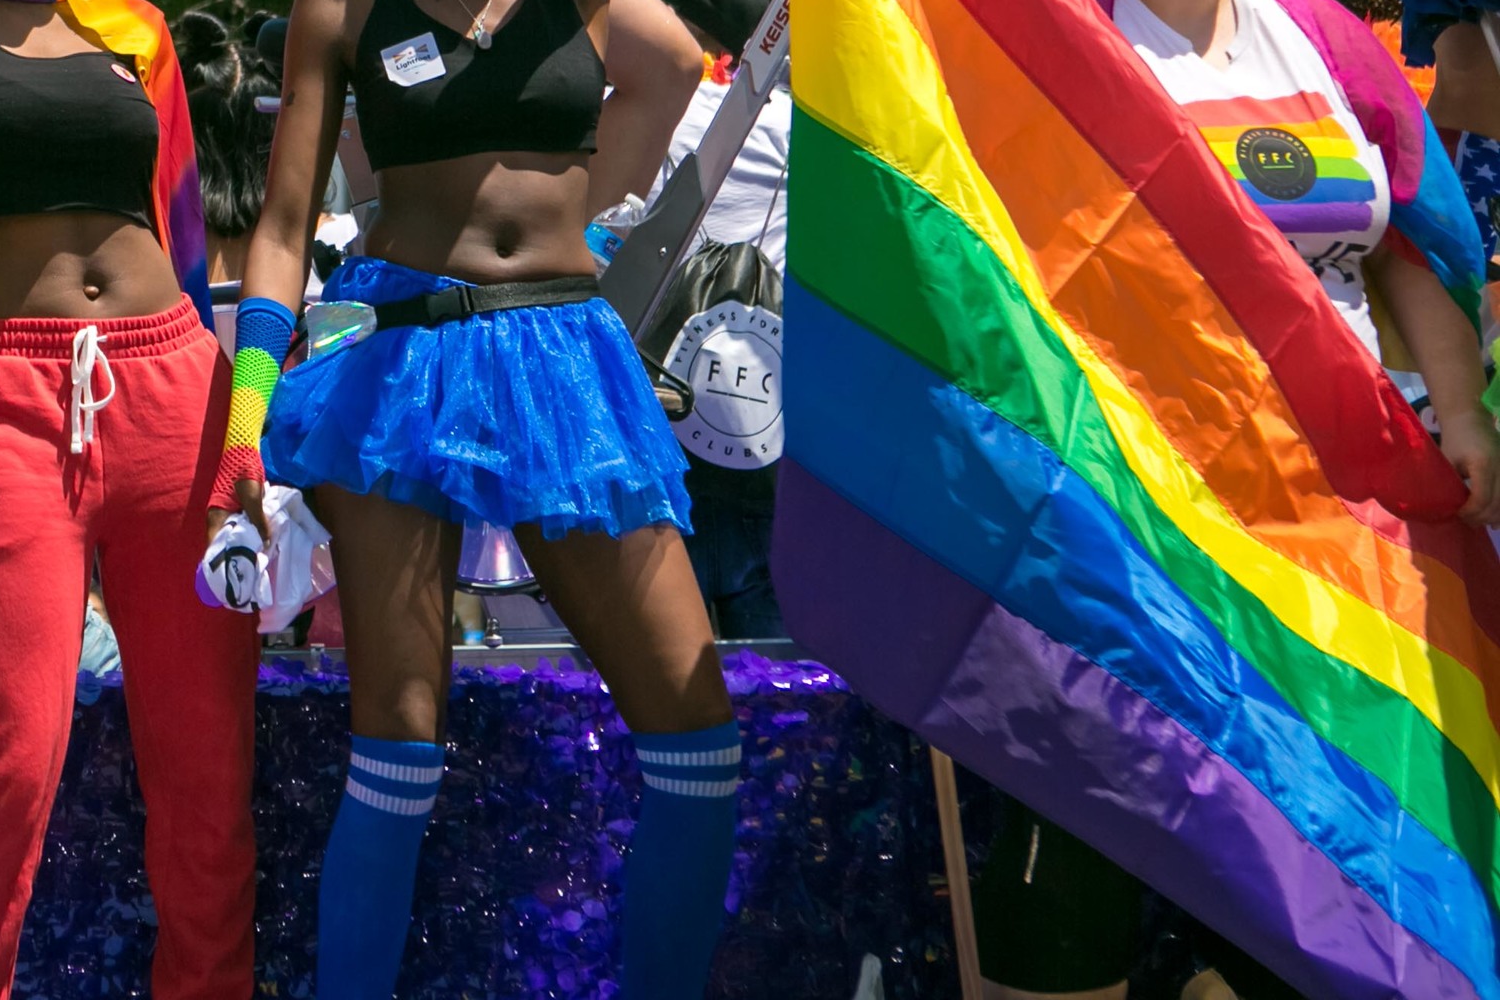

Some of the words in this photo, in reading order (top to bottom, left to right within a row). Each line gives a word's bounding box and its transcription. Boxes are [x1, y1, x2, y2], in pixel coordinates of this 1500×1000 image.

[675, 312, 736, 363] FITNESS
[749, 315, 783, 338] FOR
[691, 430, 768, 458] CLUBS
